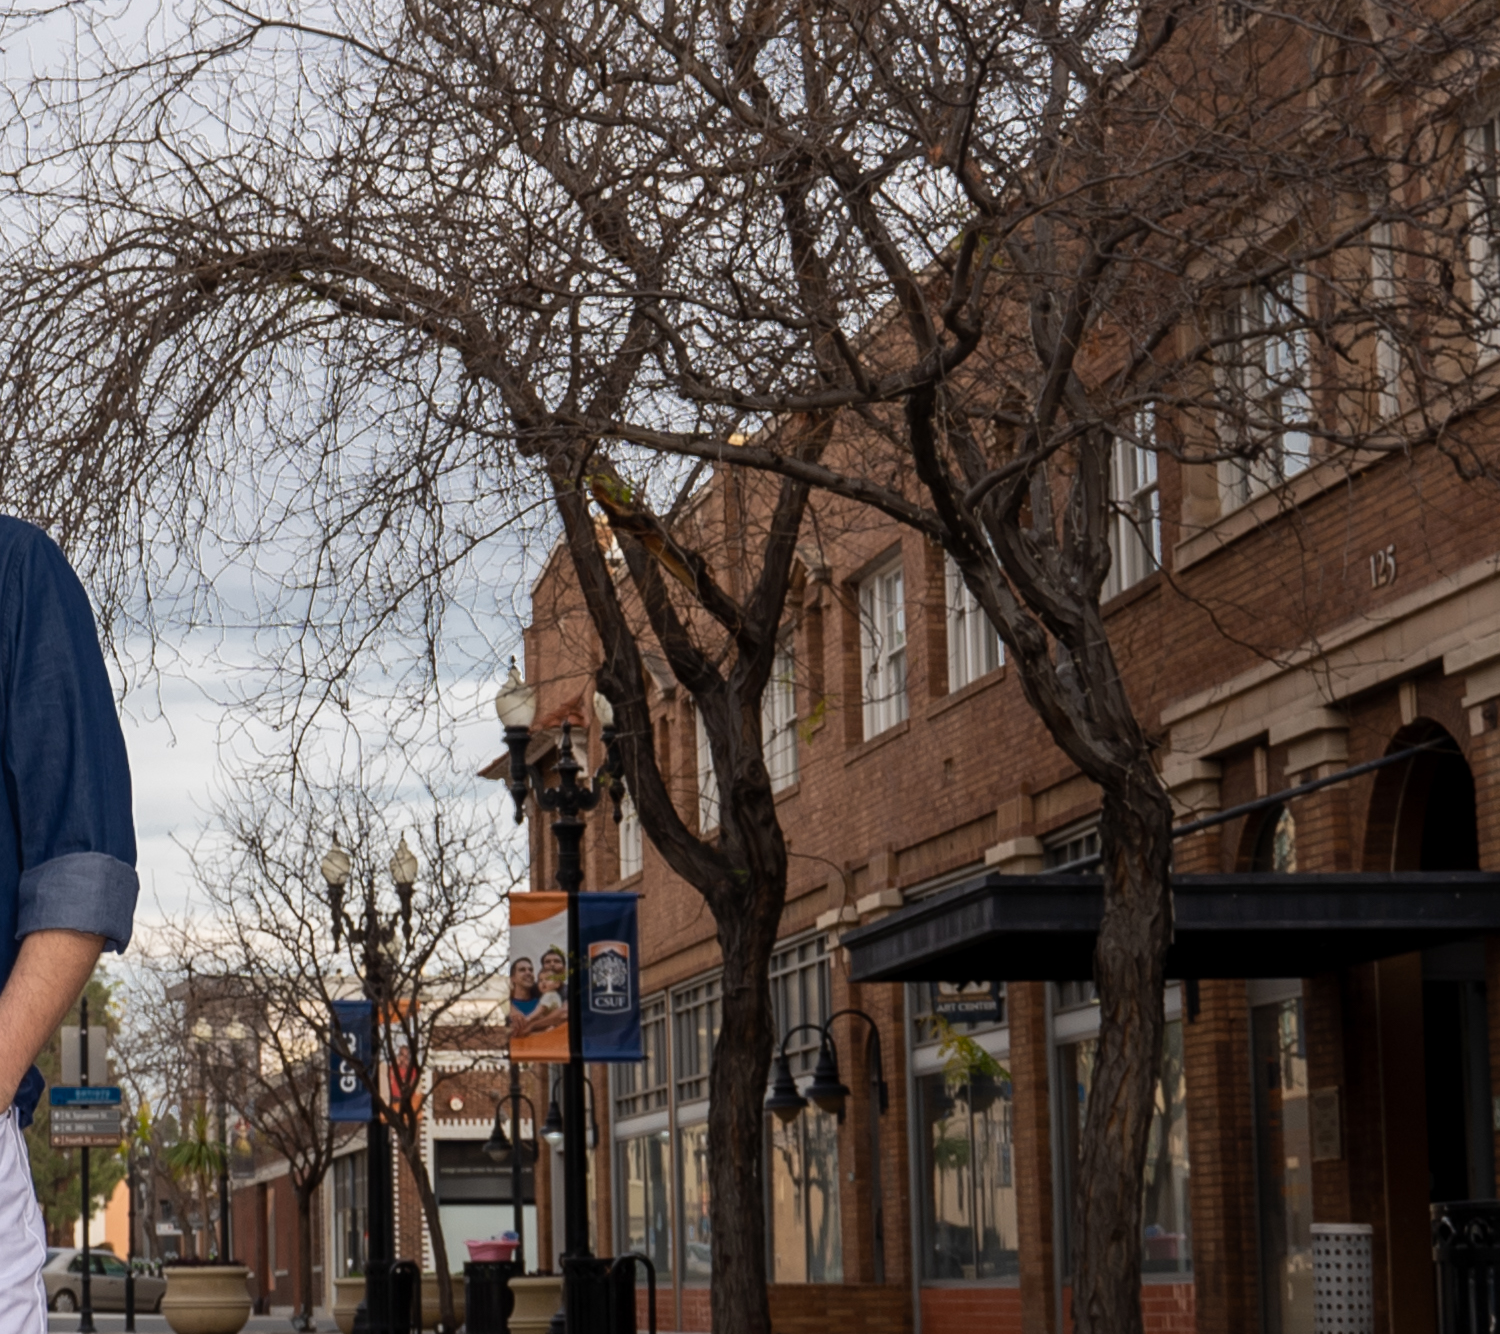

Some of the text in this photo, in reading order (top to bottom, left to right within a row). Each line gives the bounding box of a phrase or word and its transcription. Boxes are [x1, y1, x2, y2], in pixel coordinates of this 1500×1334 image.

[595, 997, 626, 1007] CSUF
[937, 1001, 997, 1012] ART CENTER
